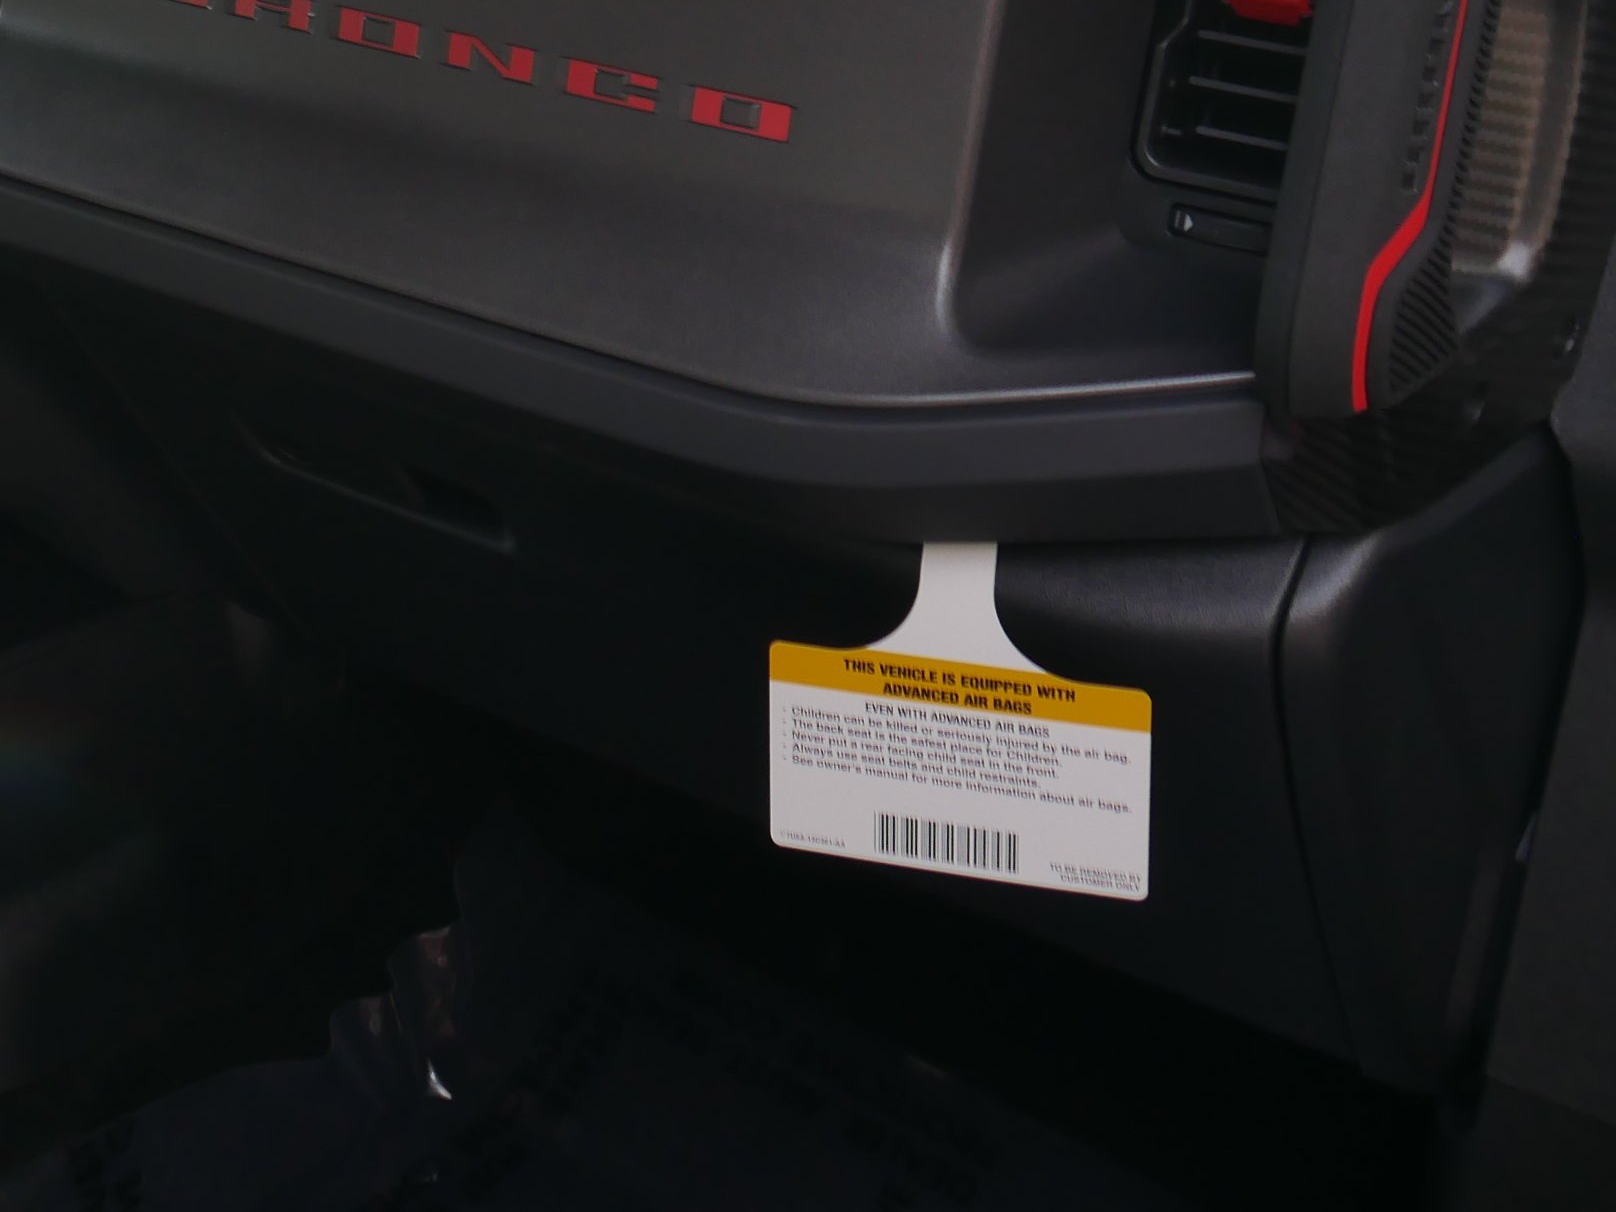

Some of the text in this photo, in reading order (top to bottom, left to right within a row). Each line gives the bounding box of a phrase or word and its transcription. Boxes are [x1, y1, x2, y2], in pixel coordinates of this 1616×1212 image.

[844, 659, 1076, 702] THIS VEHICLE IS EQUIPPED WITH
[883, 682, 1032, 715] ADVANCED AIR BAGS
[792, 706, 1131, 765] Children can be killed or seriously injured by the air bag.
[792, 719, 813, 730] The
[817, 722, 844, 735] back
[847, 728, 872, 739] seat
[889, 733, 907, 744] the
[911, 736, 947, 750] safest
[950, 741, 982, 756] place
[986, 748, 1002, 759] for
[1007, 750, 1062, 768] Children.
[865, 702, 1050, 738] EVEN WITH ADVANCED AIR BAGS
[792, 731, 824, 744] Never
[828, 737, 847, 749] put
[861, 742, 884, 753] rear
[887, 745, 924, 761] facing
[927, 751, 956, 764] child
[960, 757, 985, 769] seat
[989, 760, 1000, 770] in
[1004, 761, 1023, 773] the
[1026, 765, 1059, 779] front.
[792, 742, 1041, 788] Always use seat belts and child restraints.
[792, 755, 1132, 814] See owner's manual for more information about air bags.
